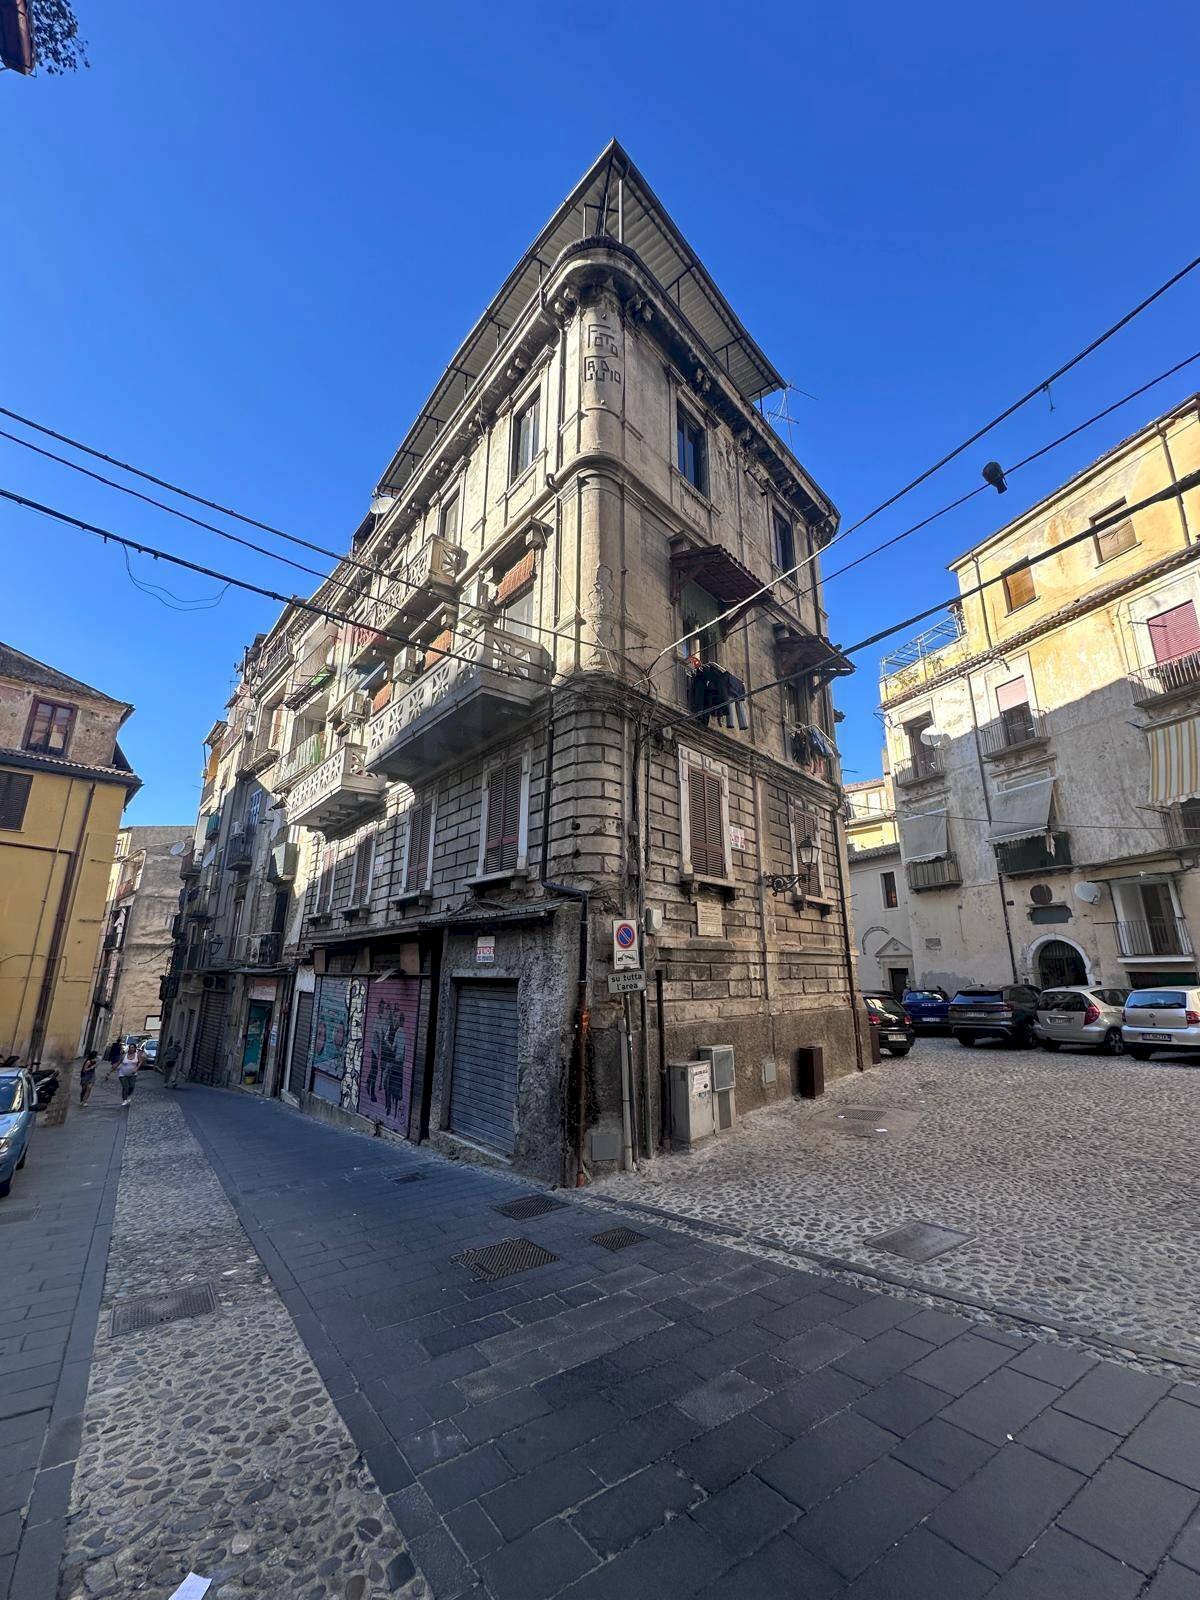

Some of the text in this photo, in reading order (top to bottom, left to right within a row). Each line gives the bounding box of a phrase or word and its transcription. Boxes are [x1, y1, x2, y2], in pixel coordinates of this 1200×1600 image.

[587, 323, 618, 358] FOTO
[623, 973, 642, 982] tutta
[616, 982, 638, 991] l'area
